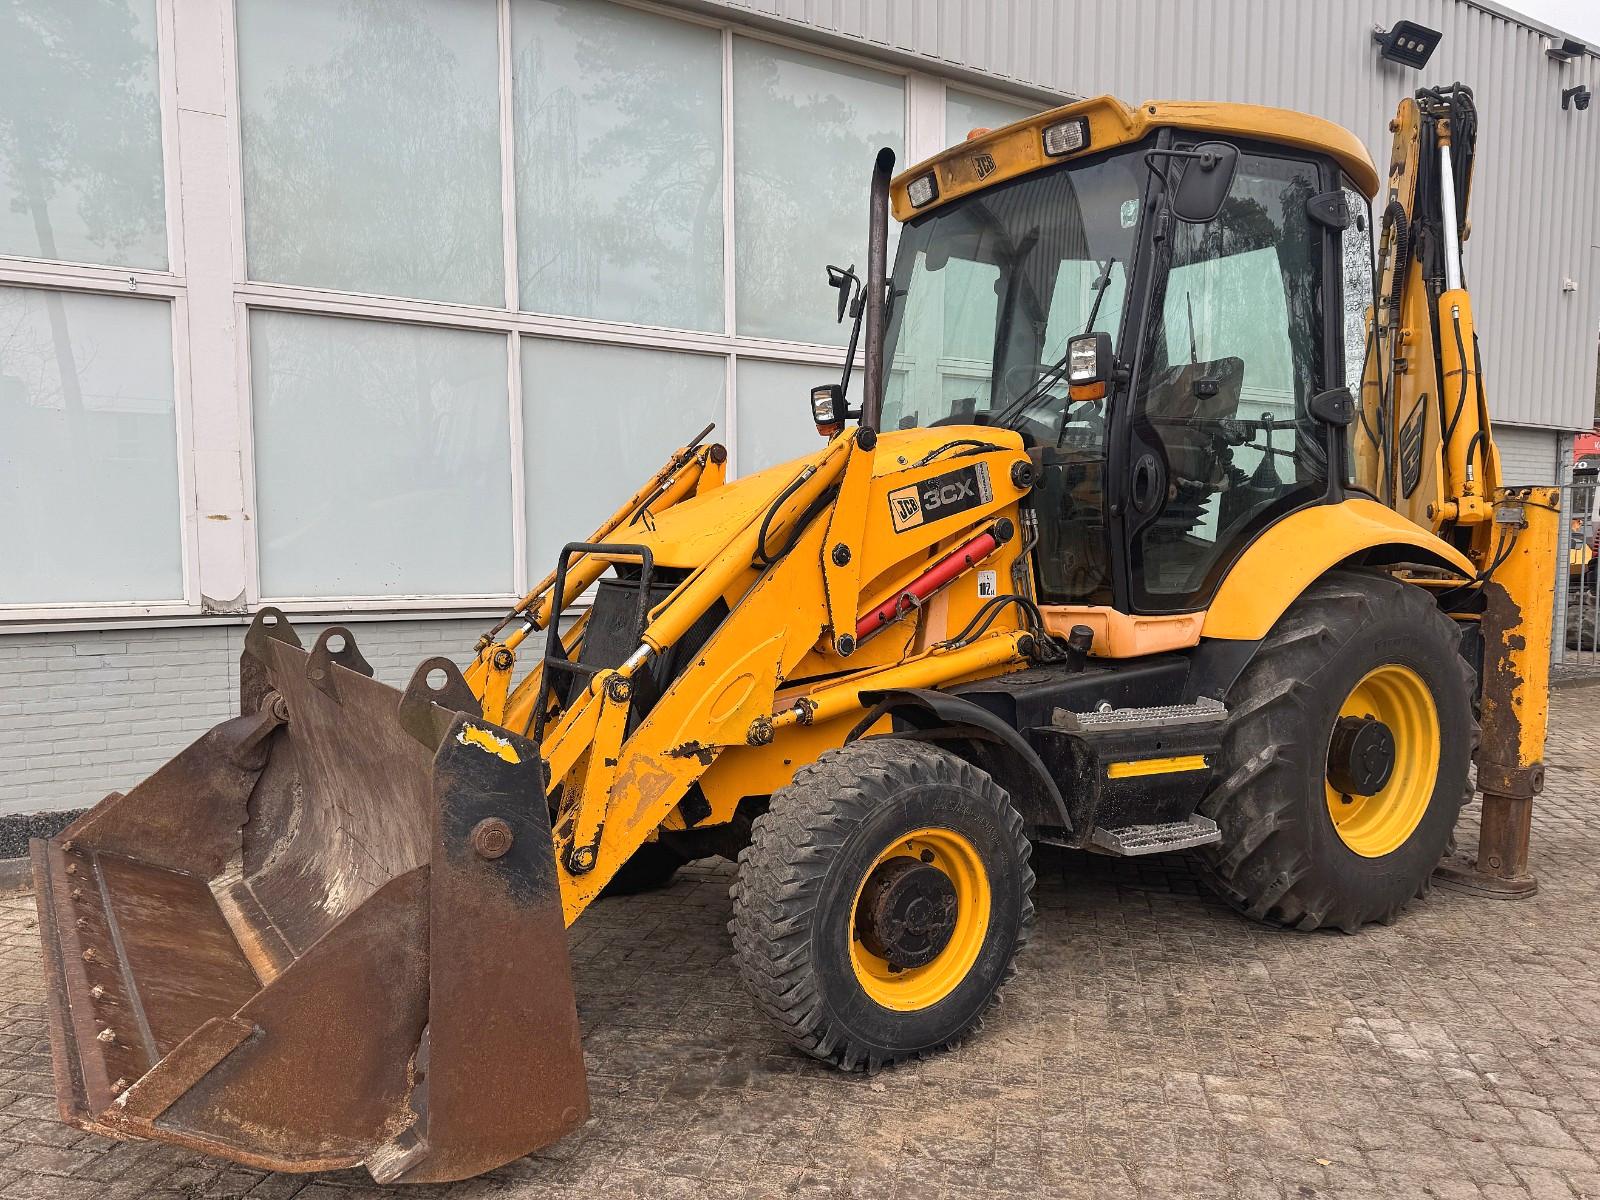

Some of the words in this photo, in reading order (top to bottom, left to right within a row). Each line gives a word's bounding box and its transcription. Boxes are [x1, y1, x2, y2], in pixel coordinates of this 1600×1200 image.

[974, 155, 995, 177] JCB
[897, 498, 919, 520] JCB
[923, 478, 975, 510] 3CX
